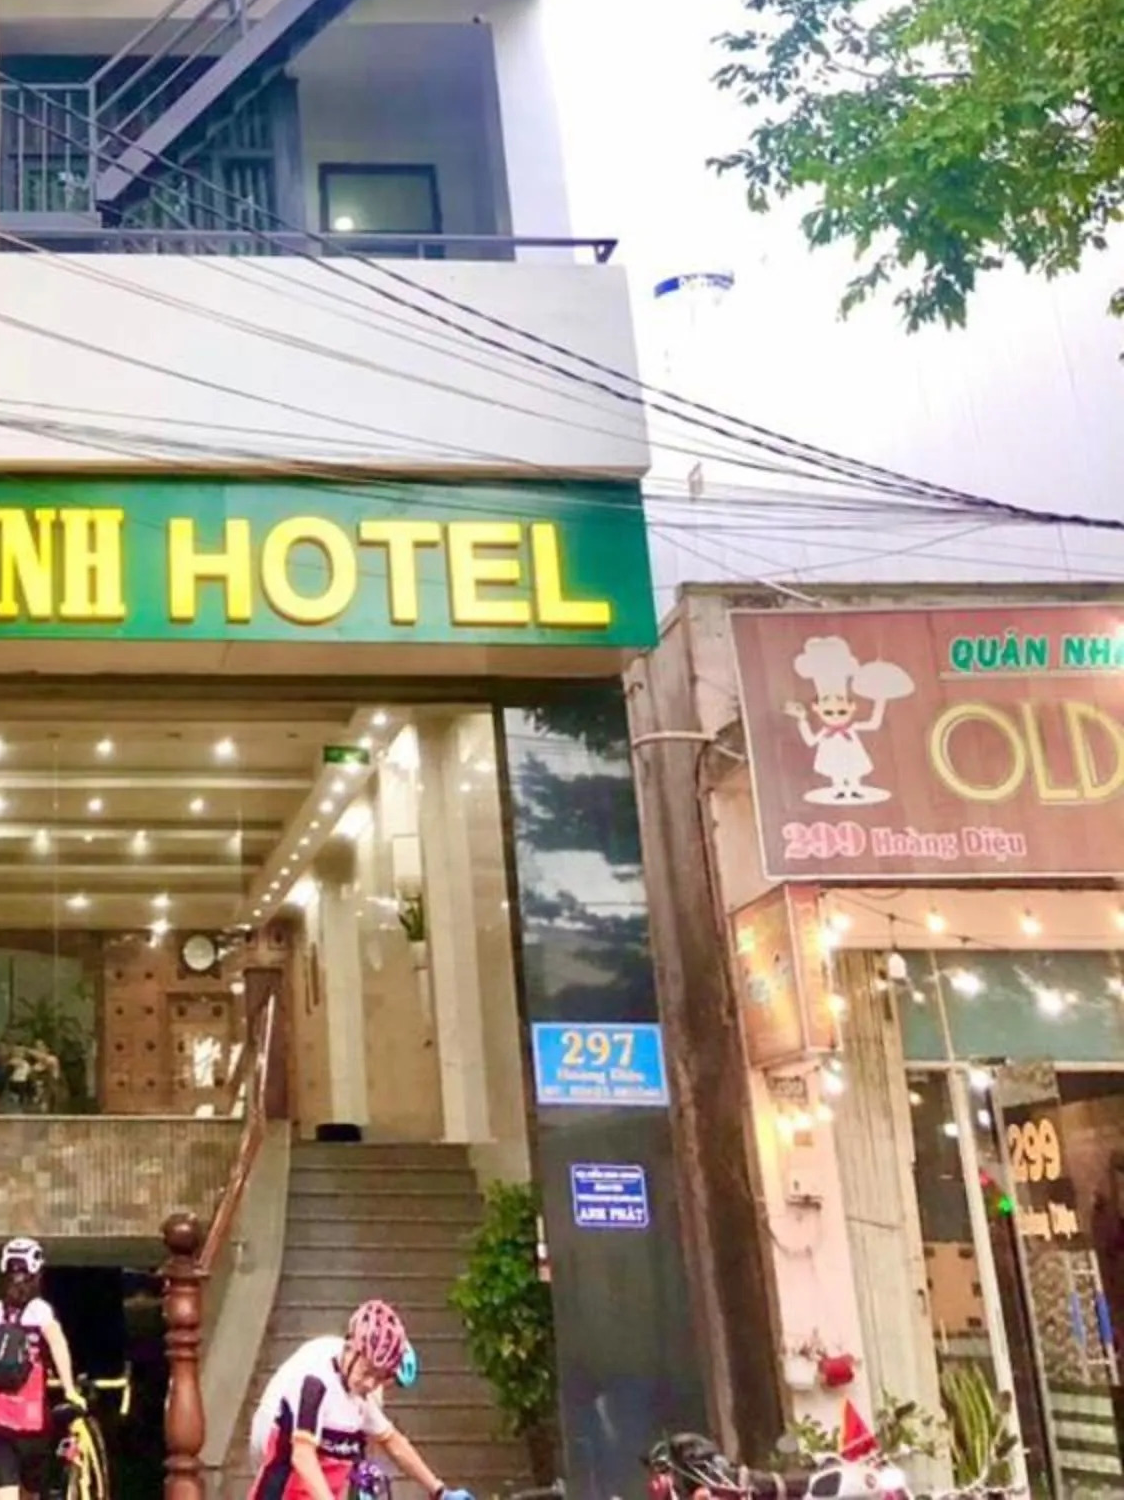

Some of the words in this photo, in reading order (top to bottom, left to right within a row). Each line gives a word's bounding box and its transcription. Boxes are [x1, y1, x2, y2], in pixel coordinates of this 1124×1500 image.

[167, 515, 612, 628] HOTEL
[931, 703, 1124, 802] OLD
[782, 821, 866, 860] 299
[870, 826, 959, 861] Hoàng
[560, 1030, 635, 1066] 297
[1007, 1118, 1061, 1183] 299
